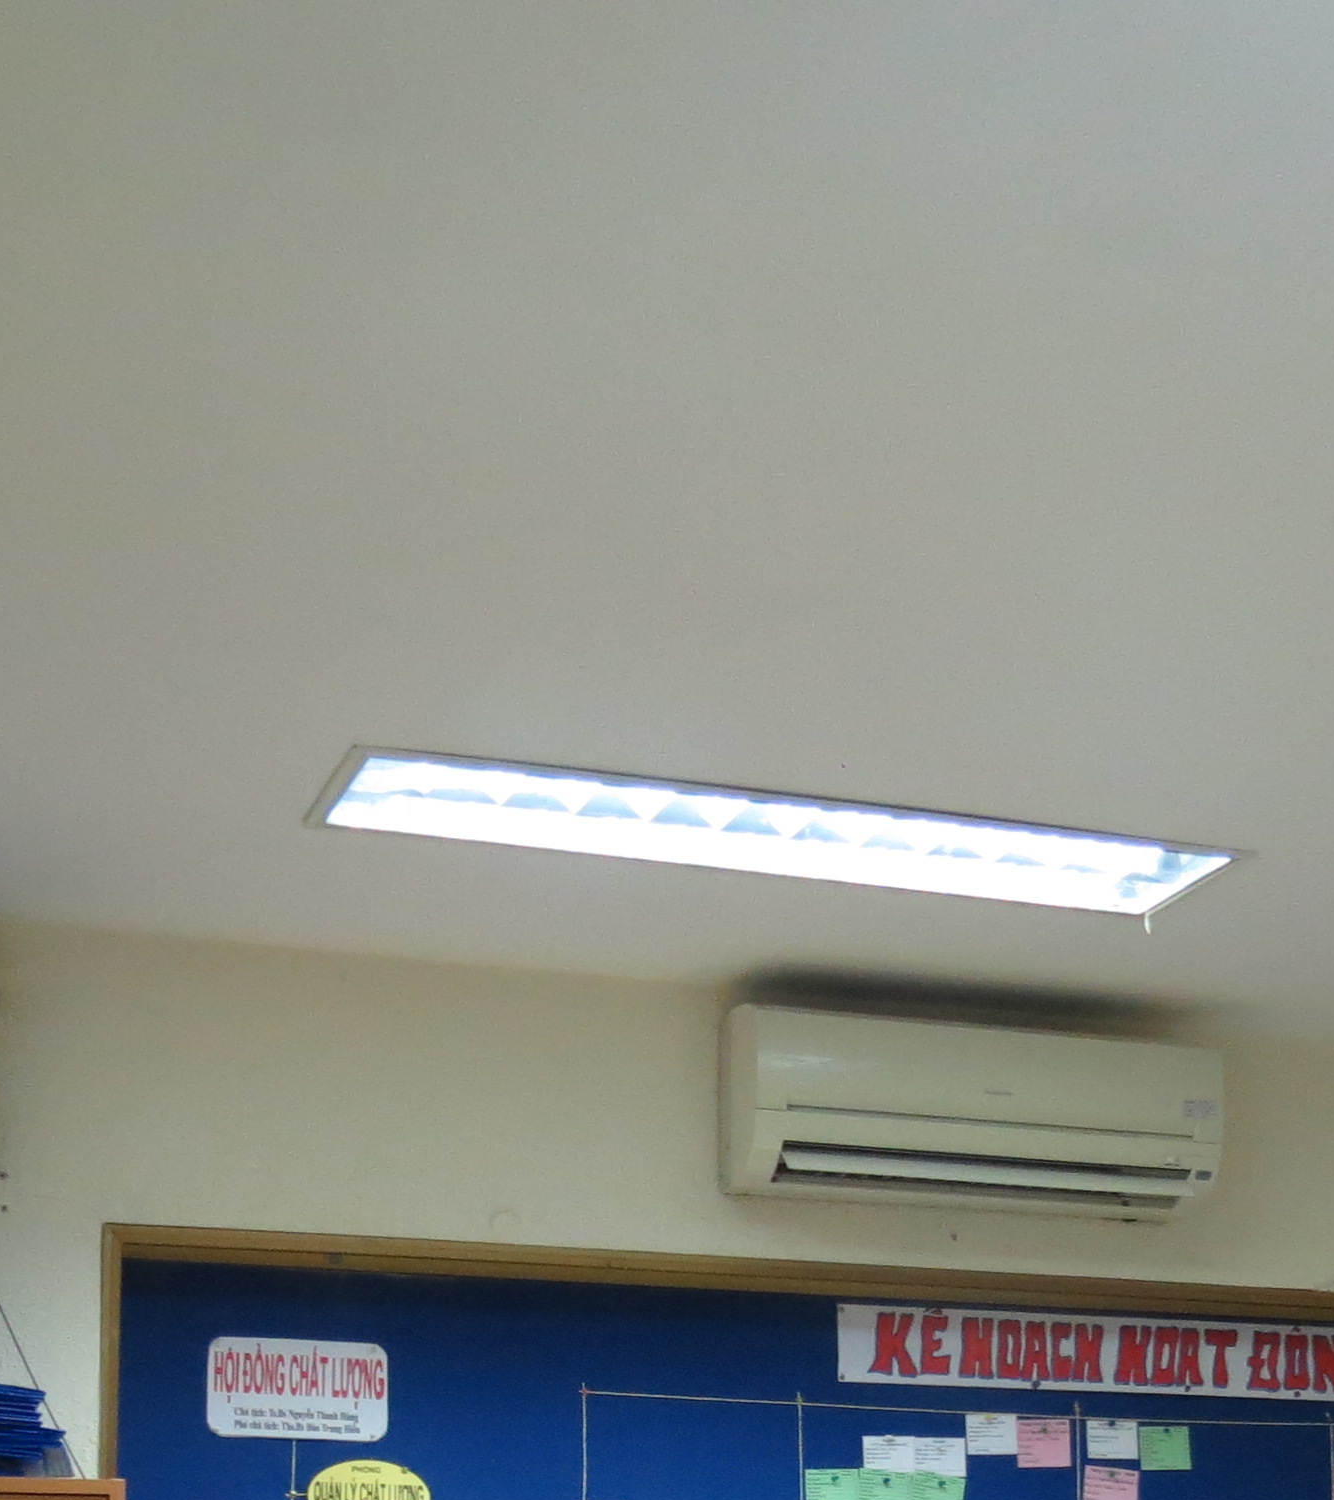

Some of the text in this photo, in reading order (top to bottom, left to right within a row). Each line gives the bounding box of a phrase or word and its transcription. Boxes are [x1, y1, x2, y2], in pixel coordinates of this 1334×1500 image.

[213, 1343, 385, 1410] HỘI ĐỒNG CHẤT LƯỢNG
[958, 1316, 1104, 1389] HOẠCH
[1114, 1324, 1239, 1392] HOẠT
